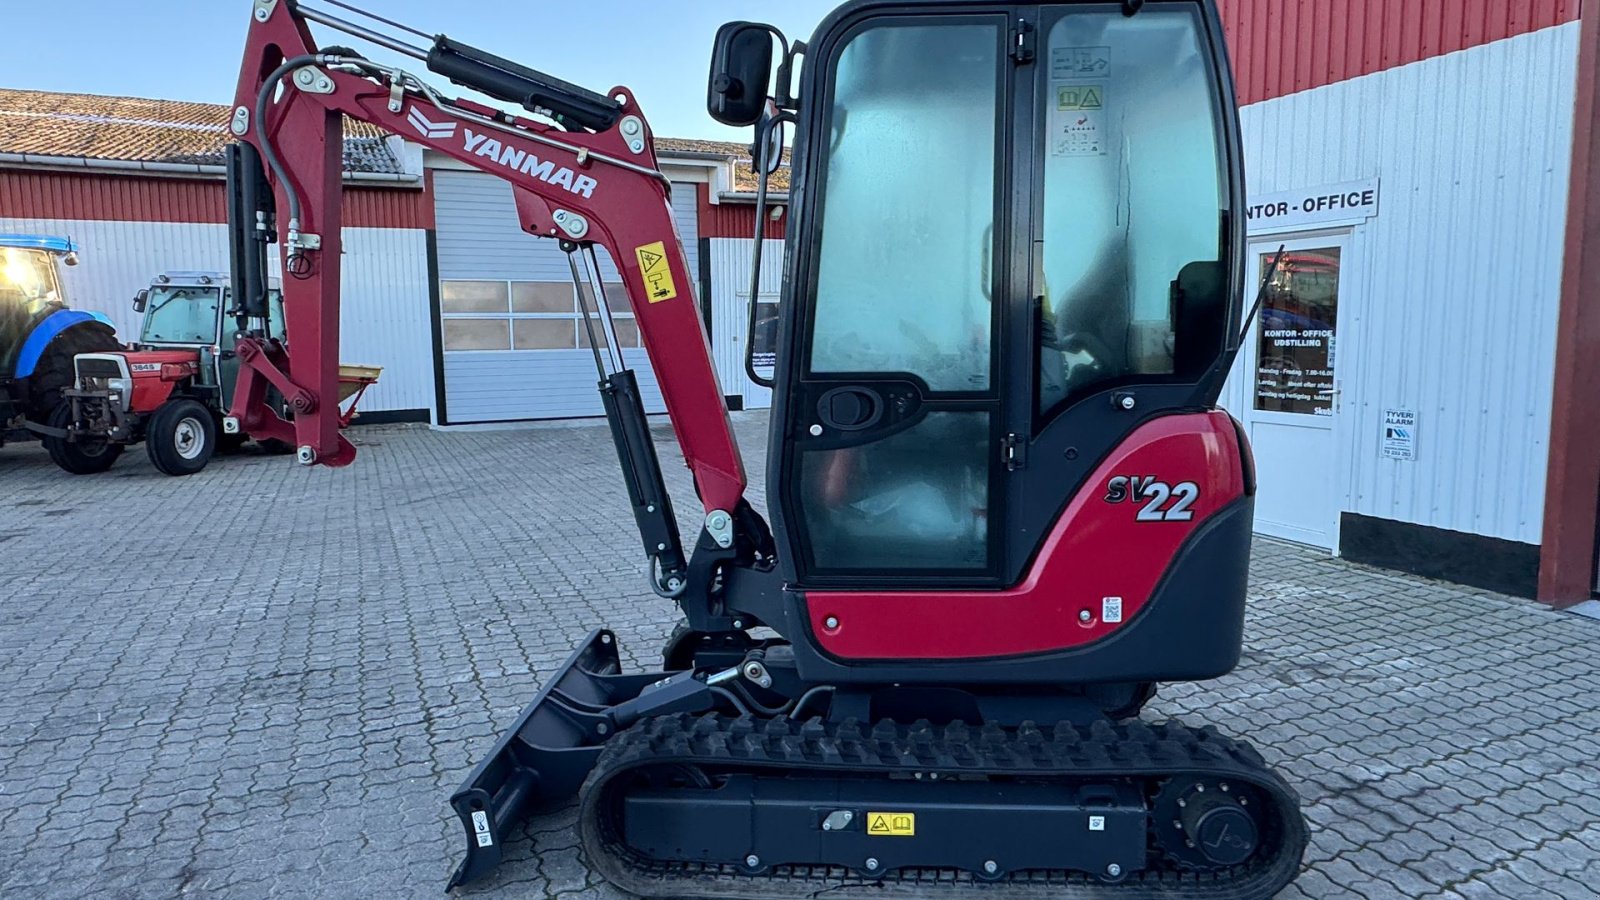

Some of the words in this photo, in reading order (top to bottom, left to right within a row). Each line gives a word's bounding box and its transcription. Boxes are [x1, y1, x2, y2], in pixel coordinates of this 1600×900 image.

[463, 128, 598, 199] YANMAR
[1303, 190, 1374, 213] OFFICE
[1274, 339, 1321, 347] UDSTILLING
